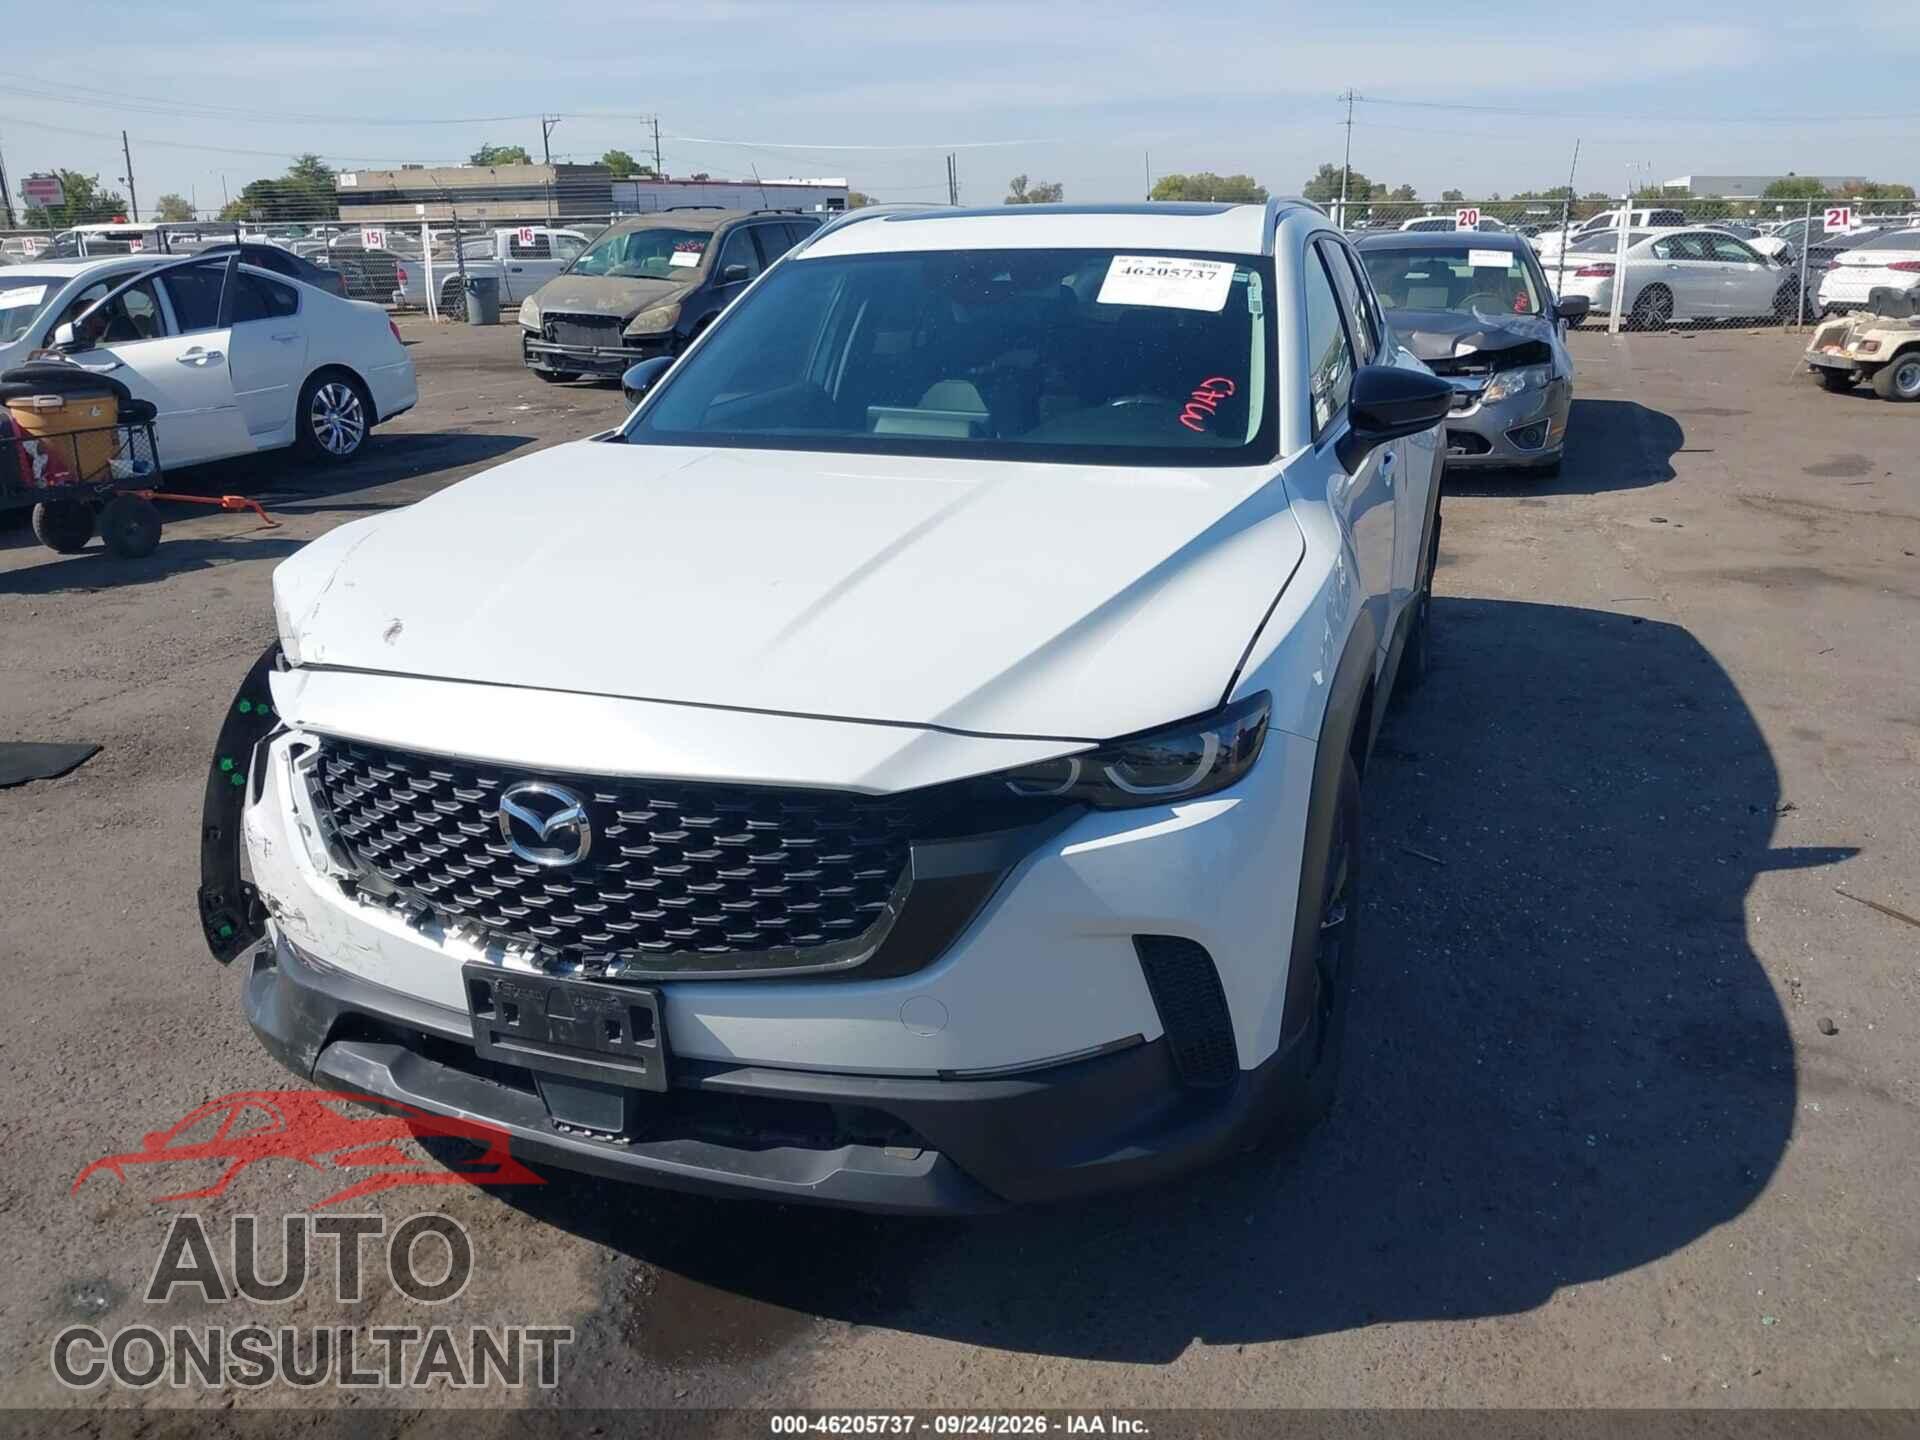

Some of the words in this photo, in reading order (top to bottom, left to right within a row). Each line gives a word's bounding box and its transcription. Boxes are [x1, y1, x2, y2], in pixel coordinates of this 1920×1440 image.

[1459, 210, 1477, 226] 20
[1827, 209, 1848, 226] 21
[520, 229, 533, 241] 16
[1120, 266, 1217, 281] 46205737
